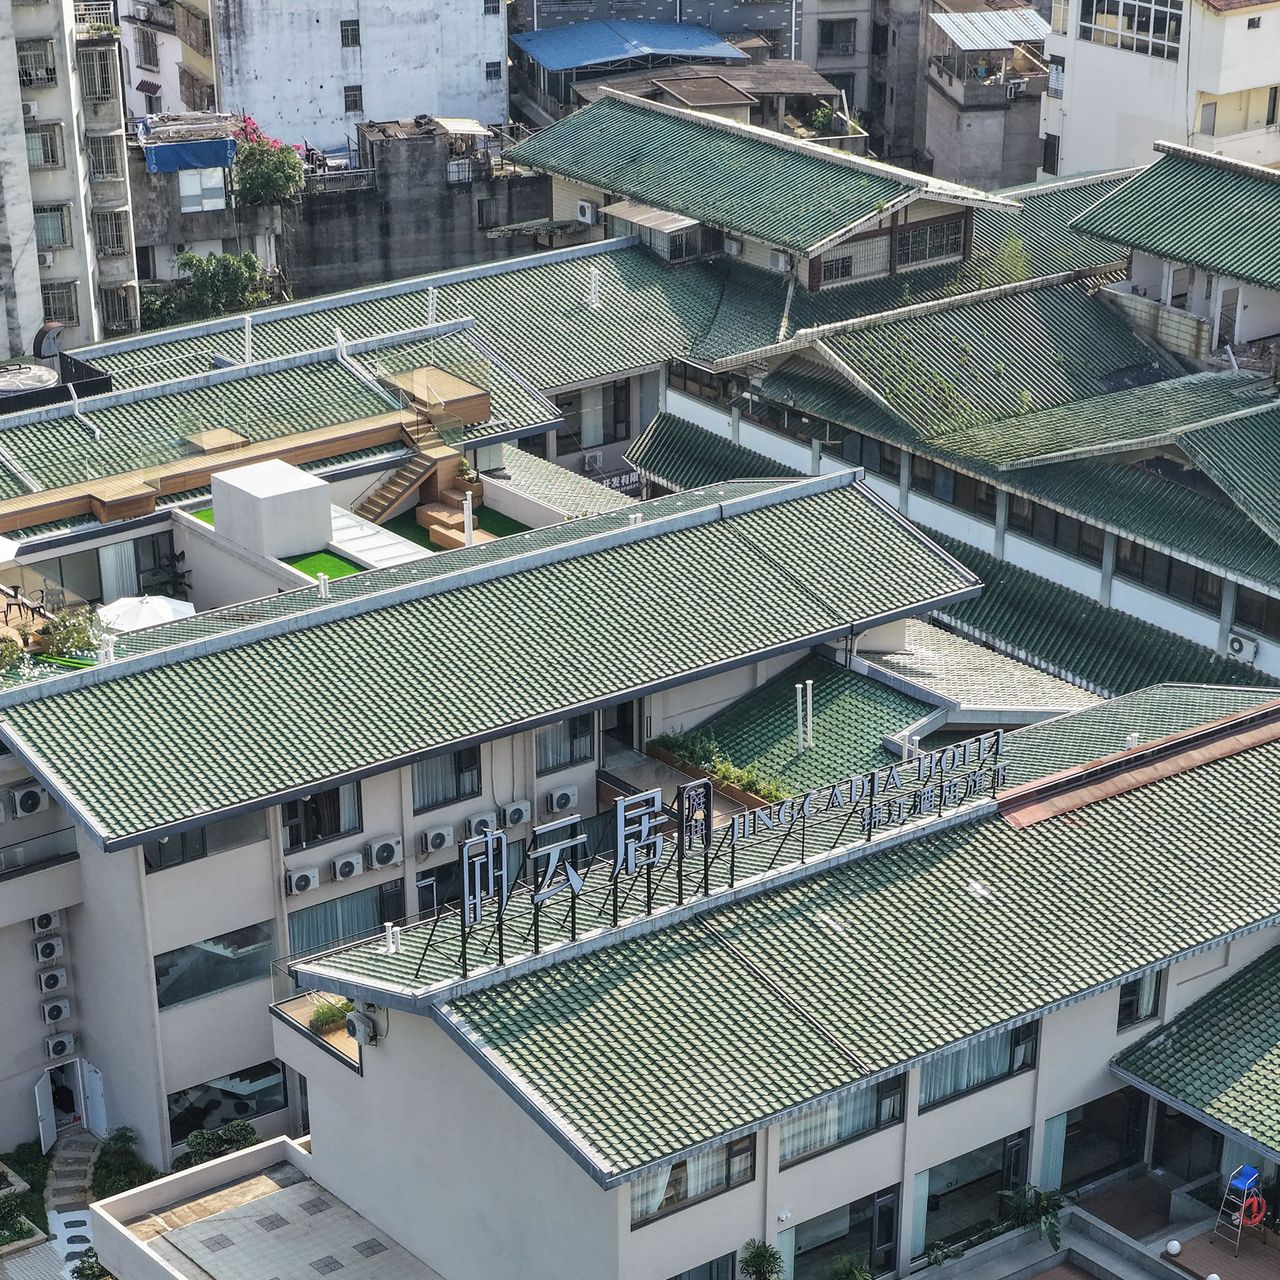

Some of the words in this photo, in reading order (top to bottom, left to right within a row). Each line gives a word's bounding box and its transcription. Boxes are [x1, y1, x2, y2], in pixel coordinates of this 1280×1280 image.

[729, 764, 903, 846] JINGCADIA
[918, 728, 1005, 781] HOTEL
[860, 761, 1011, 833] 锦江酒店旗下
